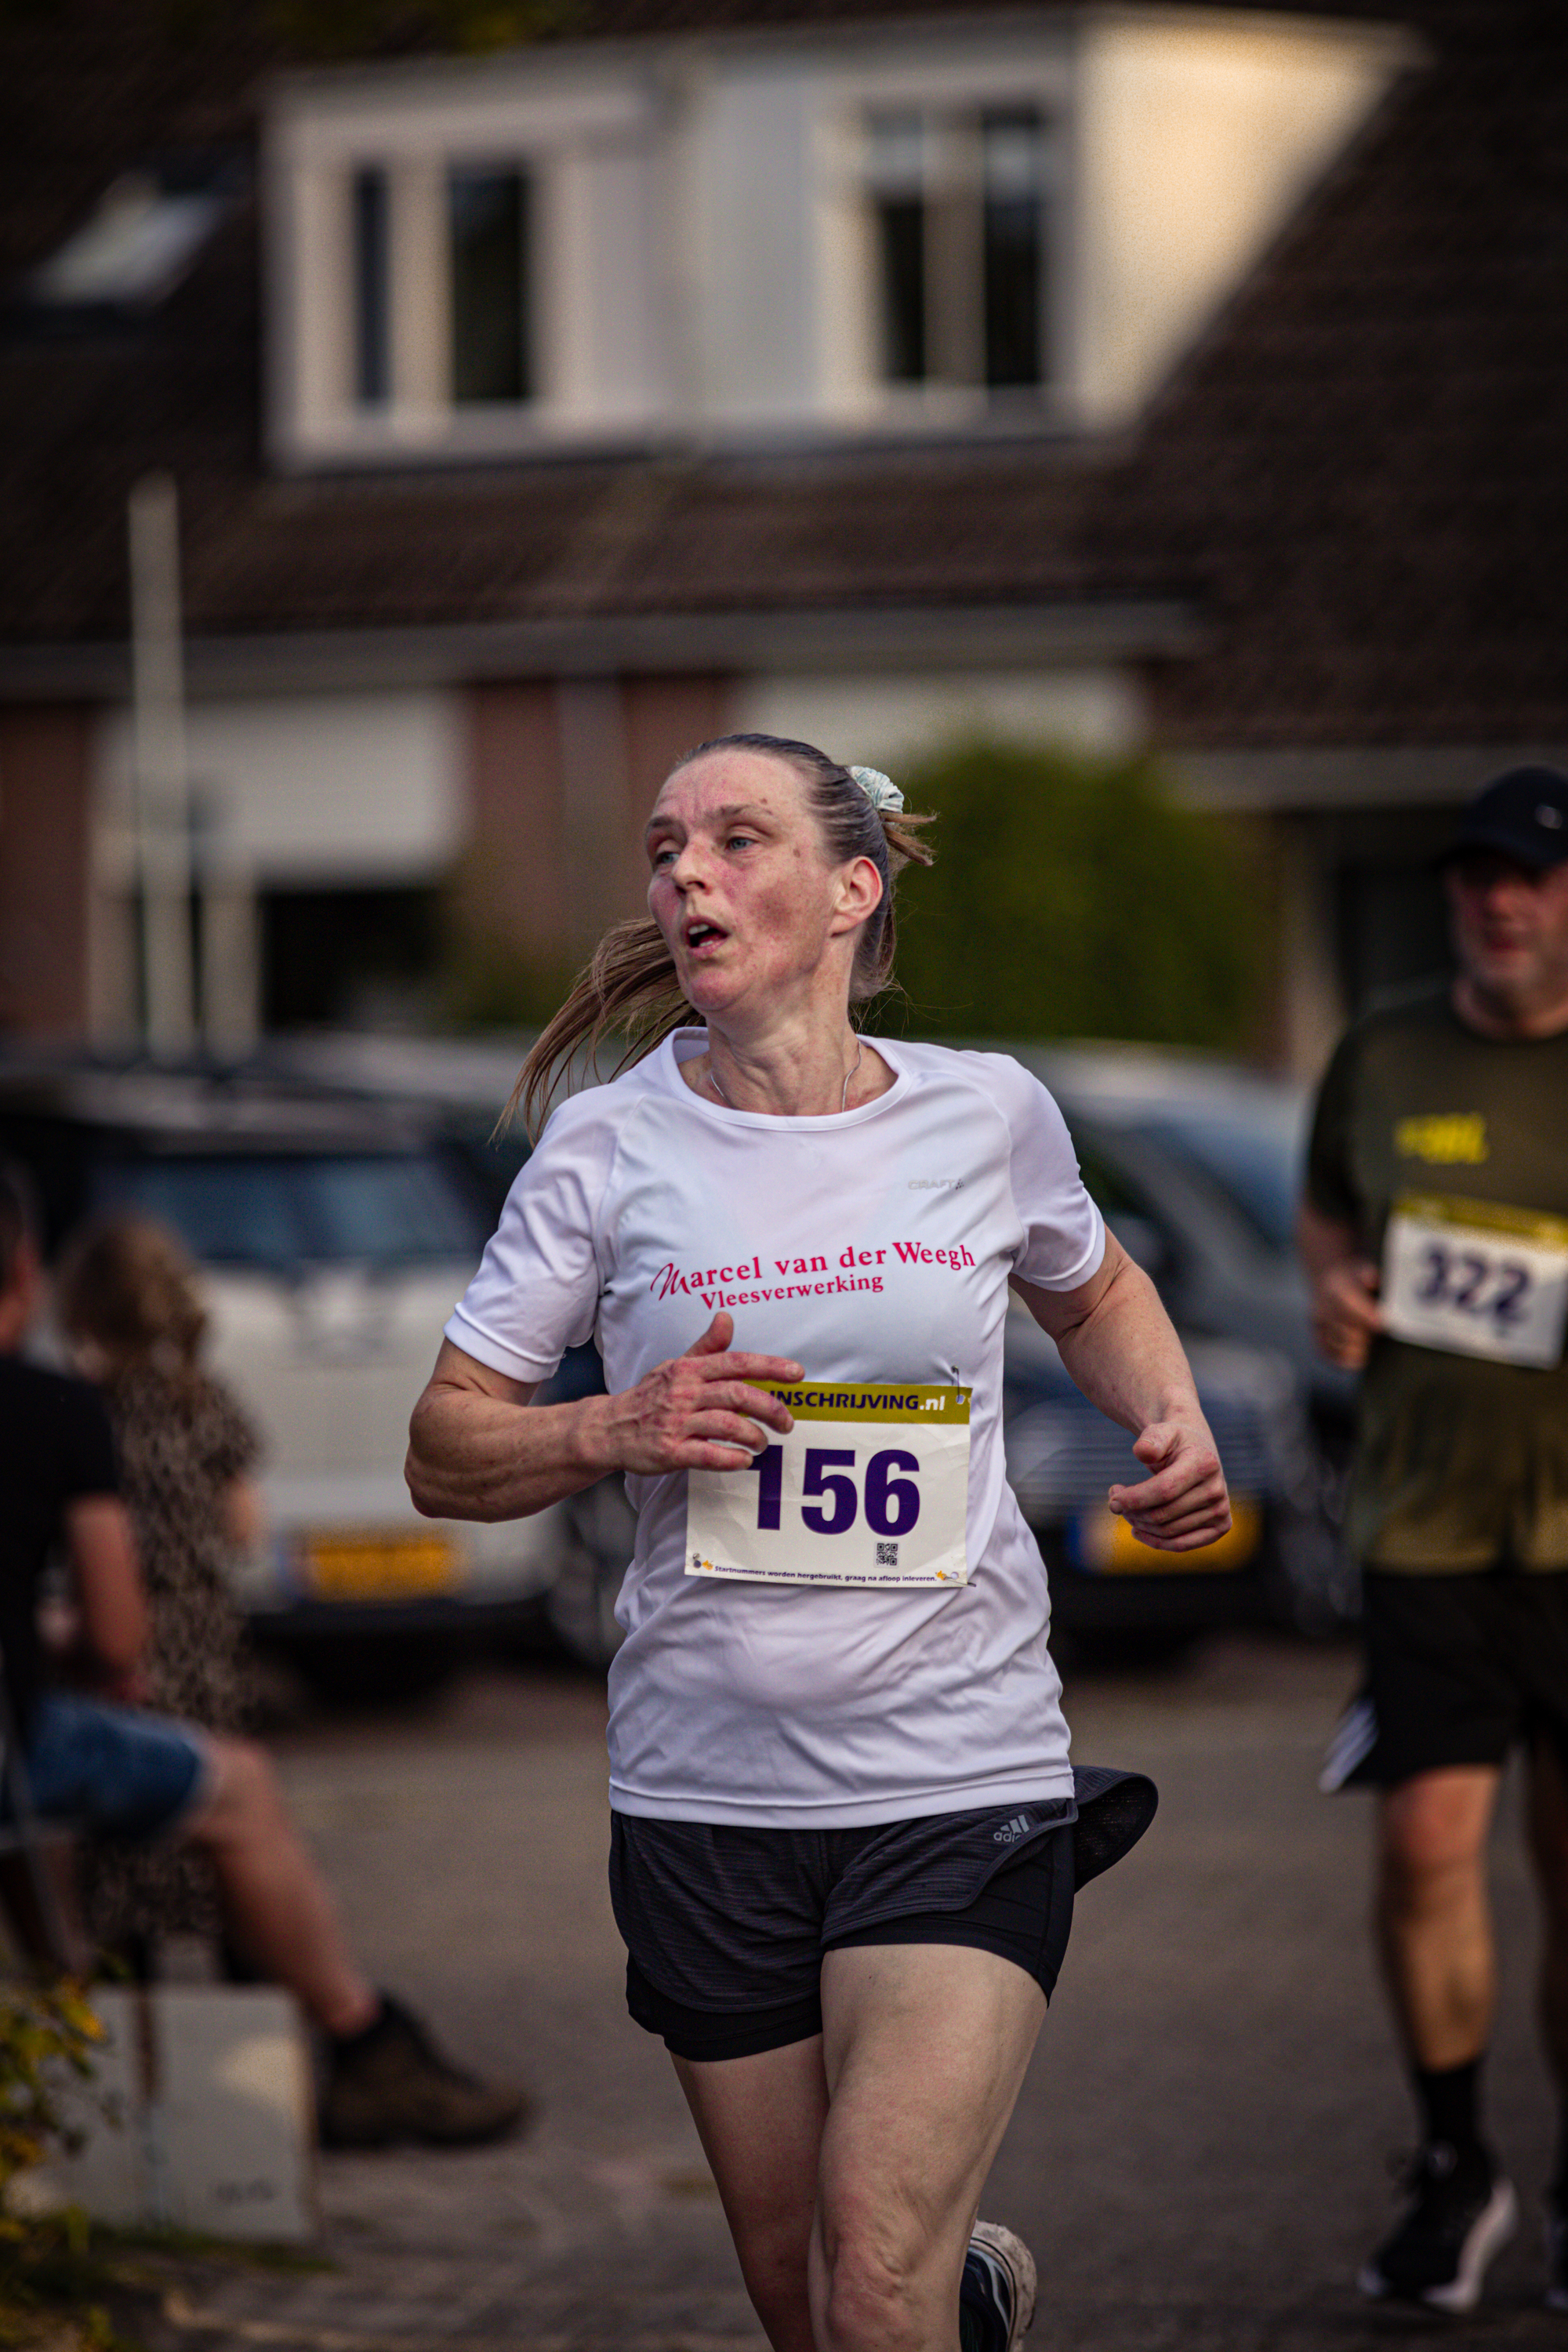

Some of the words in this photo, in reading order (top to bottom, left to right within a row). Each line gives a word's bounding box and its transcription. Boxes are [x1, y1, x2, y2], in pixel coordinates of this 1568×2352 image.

[908, 1179, 955, 1190] CRAFT
[650, 1256, 762, 1301] Marcel
[775, 1255, 829, 1276] van
[839, 1246, 887, 1269] der
[891, 1242, 976, 1271] Weegh
[701, 1274, 884, 1310] Vleesverwerking
[746, 1444, 920, 1537] 156
[714, 1566, 766, 1576] Startnummers
